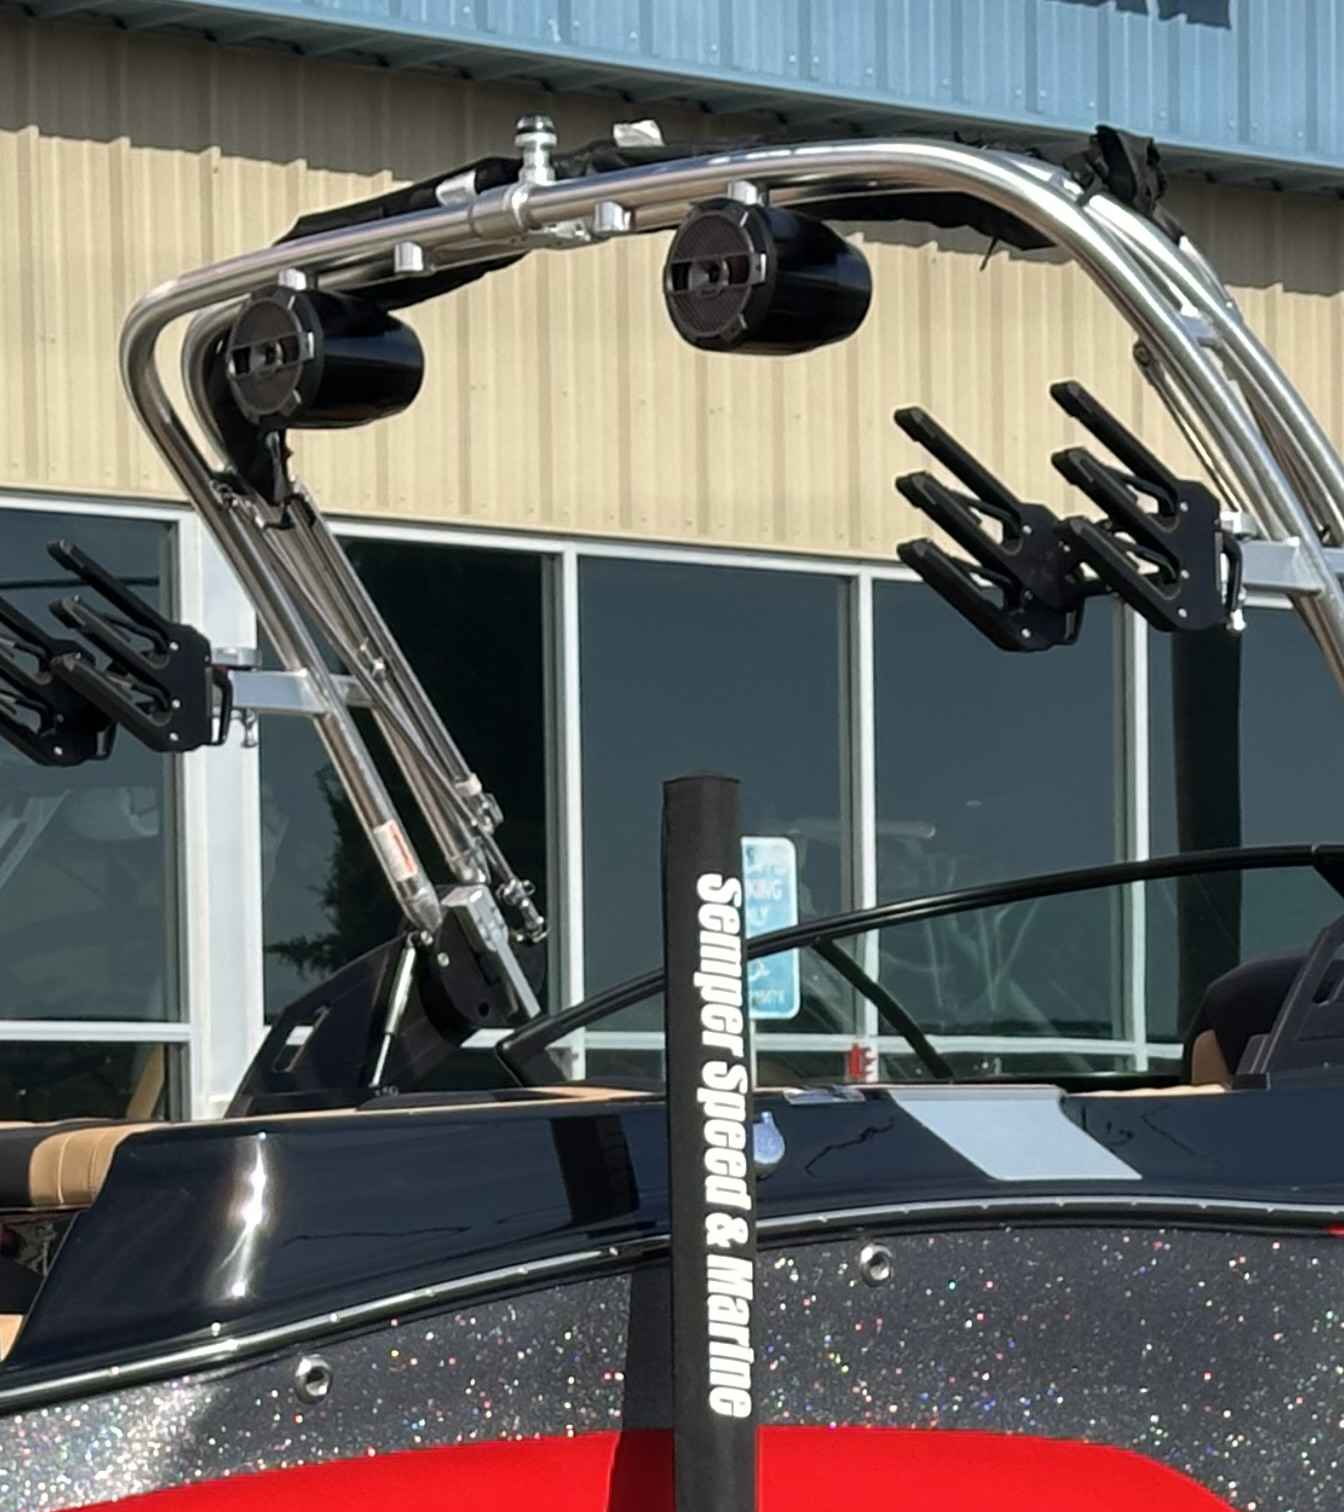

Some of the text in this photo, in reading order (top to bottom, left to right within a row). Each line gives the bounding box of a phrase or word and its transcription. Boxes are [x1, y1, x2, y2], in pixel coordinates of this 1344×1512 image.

[693, 873, 755, 1419] Semper Speed & Marine
